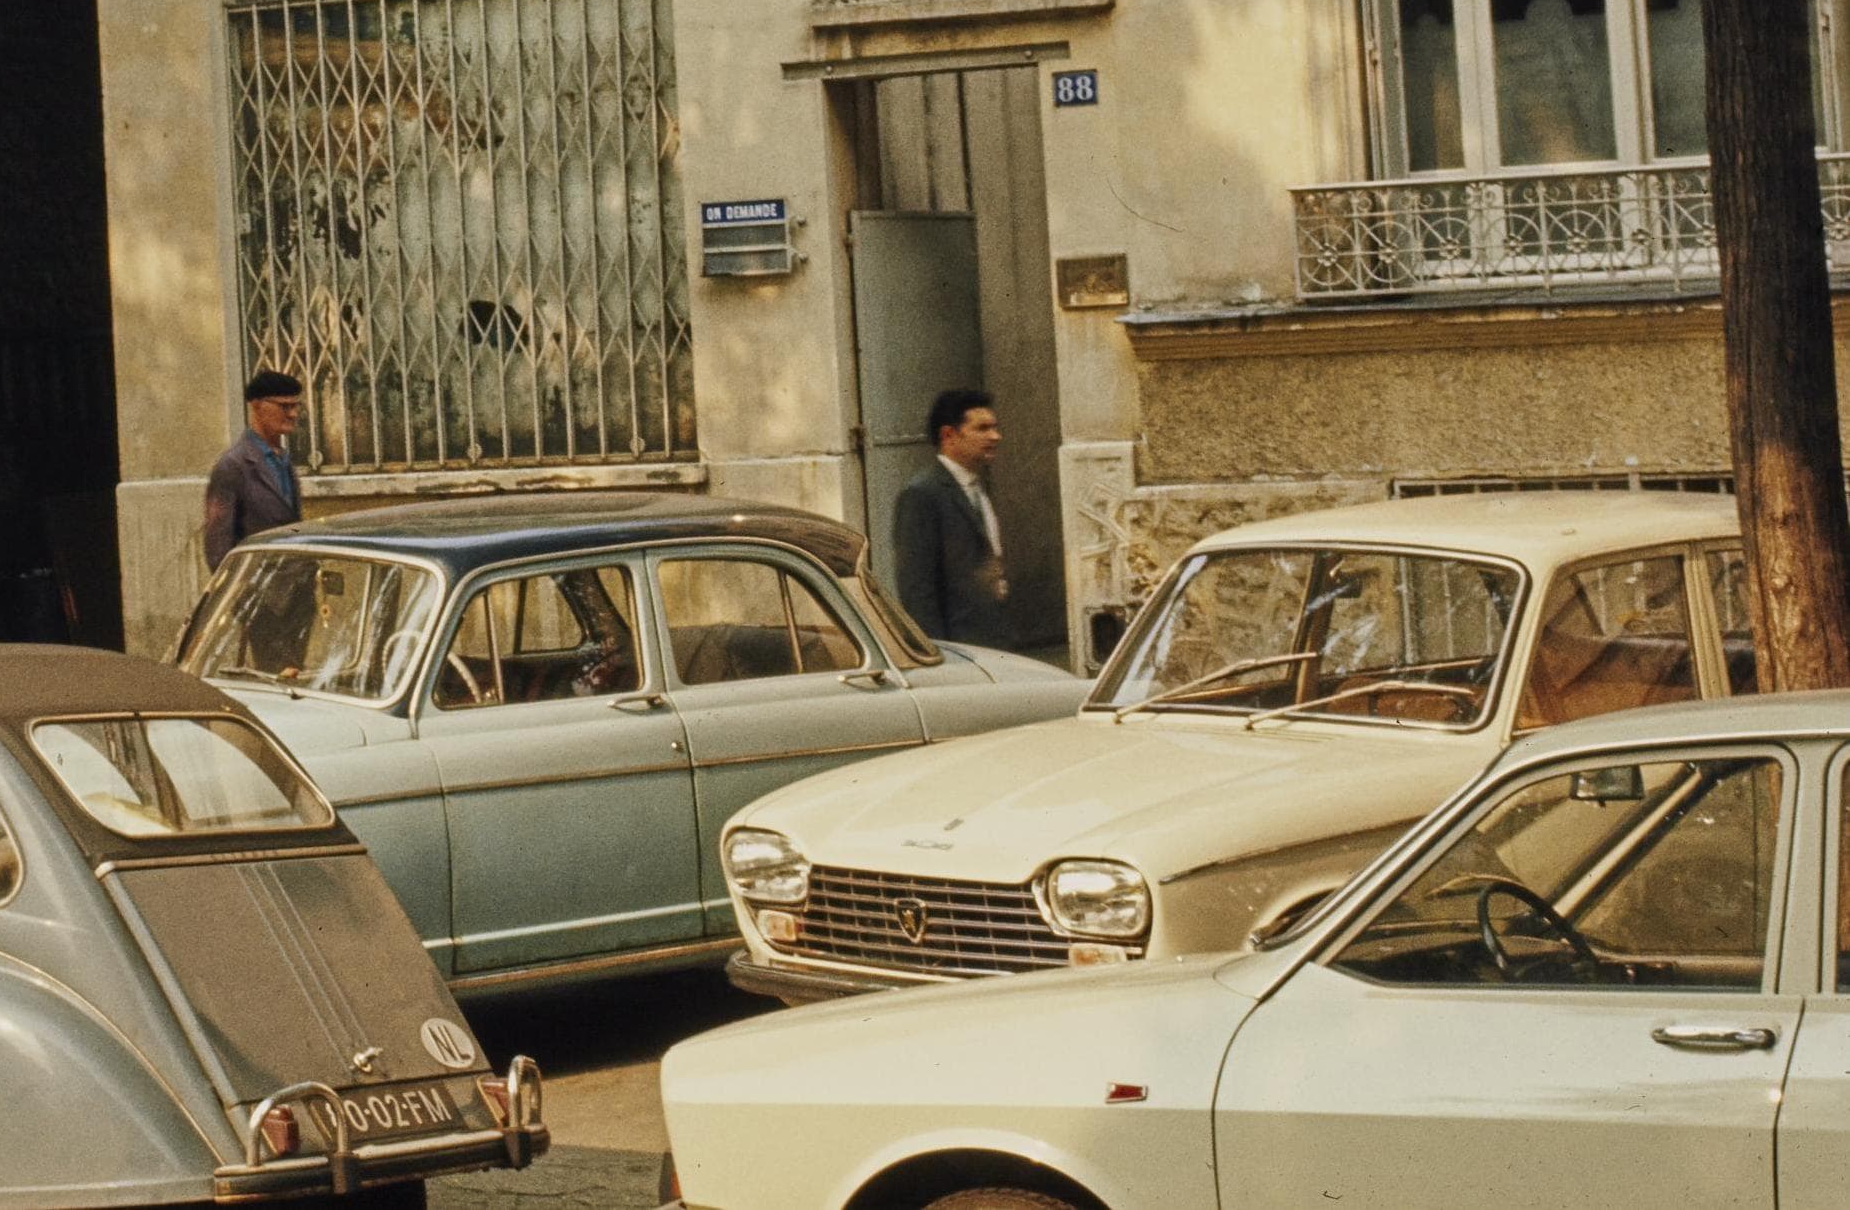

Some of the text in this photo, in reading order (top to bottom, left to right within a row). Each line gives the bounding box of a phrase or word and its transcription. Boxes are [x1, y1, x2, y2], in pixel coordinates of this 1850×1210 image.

[1057, 75, 1094, 103] 88
[726, 203, 777, 220] DEMANDE
[428, 1024, 471, 1062] NL
